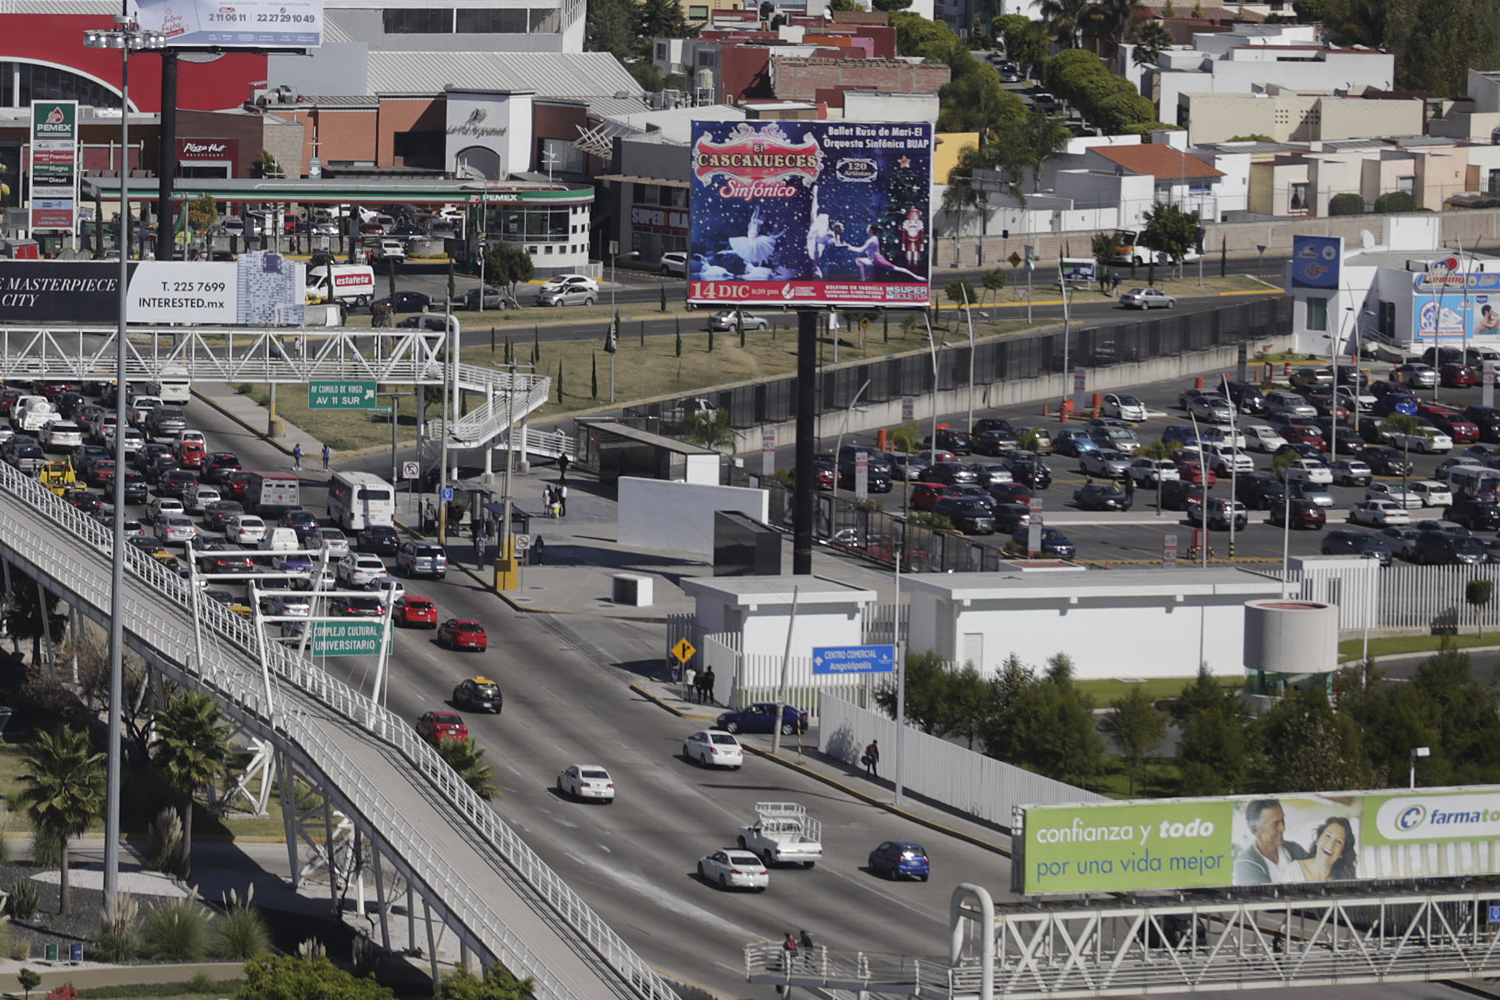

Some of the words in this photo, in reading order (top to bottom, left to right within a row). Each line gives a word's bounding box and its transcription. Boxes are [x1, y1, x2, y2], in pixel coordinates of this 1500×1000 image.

[209, 13, 215, 22] 2
[216, 13, 224, 22] 11
[225, 13, 237, 22] 06
[239, 13, 246, 22] 11
[257, 14, 268, 22] 22
[268, 14, 279, 22] 27
[280, 14, 291, 23] 29
[292, 14, 302, 23] 10
[303, 14, 315, 23] 49
[828, 126, 855, 137] Ballet
[856, 127, 876, 137] Ruso
[878, 127, 889, 137] de
[892, 127, 923, 137] Mari-El
[183, 143, 208, 153] Pizza
[208, 143, 227, 153] Hut
[824, 138, 864, 149] Orquesta
[865, 137, 905, 149] Sinfónica
[907, 138, 930, 149] BUAP
[698, 154, 818, 168] CASCANUECES
[848, 162, 868, 171] 120
[49, 165, 69, 173] Magna
[843, 169, 872, 177] Artistas
[719, 179, 797, 200] Sinfónico
[483, 194, 518, 202] PEMEX
[4, 278, 119, 293] MASTERPIECE
[336, 275, 370, 285] estafeta
[162, 282, 171, 292] T.
[173, 281, 195, 293] 225
[197, 281, 226, 293] 7699
[692, 282, 717, 299] 14
[718, 284, 750, 298] DIC
[894, 286, 928, 294] SUPER
[0, 293, 39, 308] CITY
[138, 297, 226, 310] INTERESTED.mx
[311, 385, 318, 394] AV
[340, 386, 347, 394] DE
[348, 385, 363, 394] VIRGO
[316, 396, 329, 405] AV
[332, 396, 338, 404] 11
[341, 396, 361, 405] SUR
[313, 626, 345, 637] COMPLEJO
[347, 625, 378, 637] CULTURAL
[315, 638, 376, 650] UNIVERSITARIO
[824, 650, 845, 660] CENTRO
[846, 649, 878, 659] COMERCIAL
[829, 660, 873, 672] Angelópolis
[1036, 817, 1134, 845] confianza
[1139, 823, 1153, 846] y
[1158, 817, 1215, 840] todo
[1036, 860, 1071, 884] por
[1076, 858, 1114, 876] una
[1120, 850, 1163, 874] vida
[1169, 850, 1226, 877] mejor
